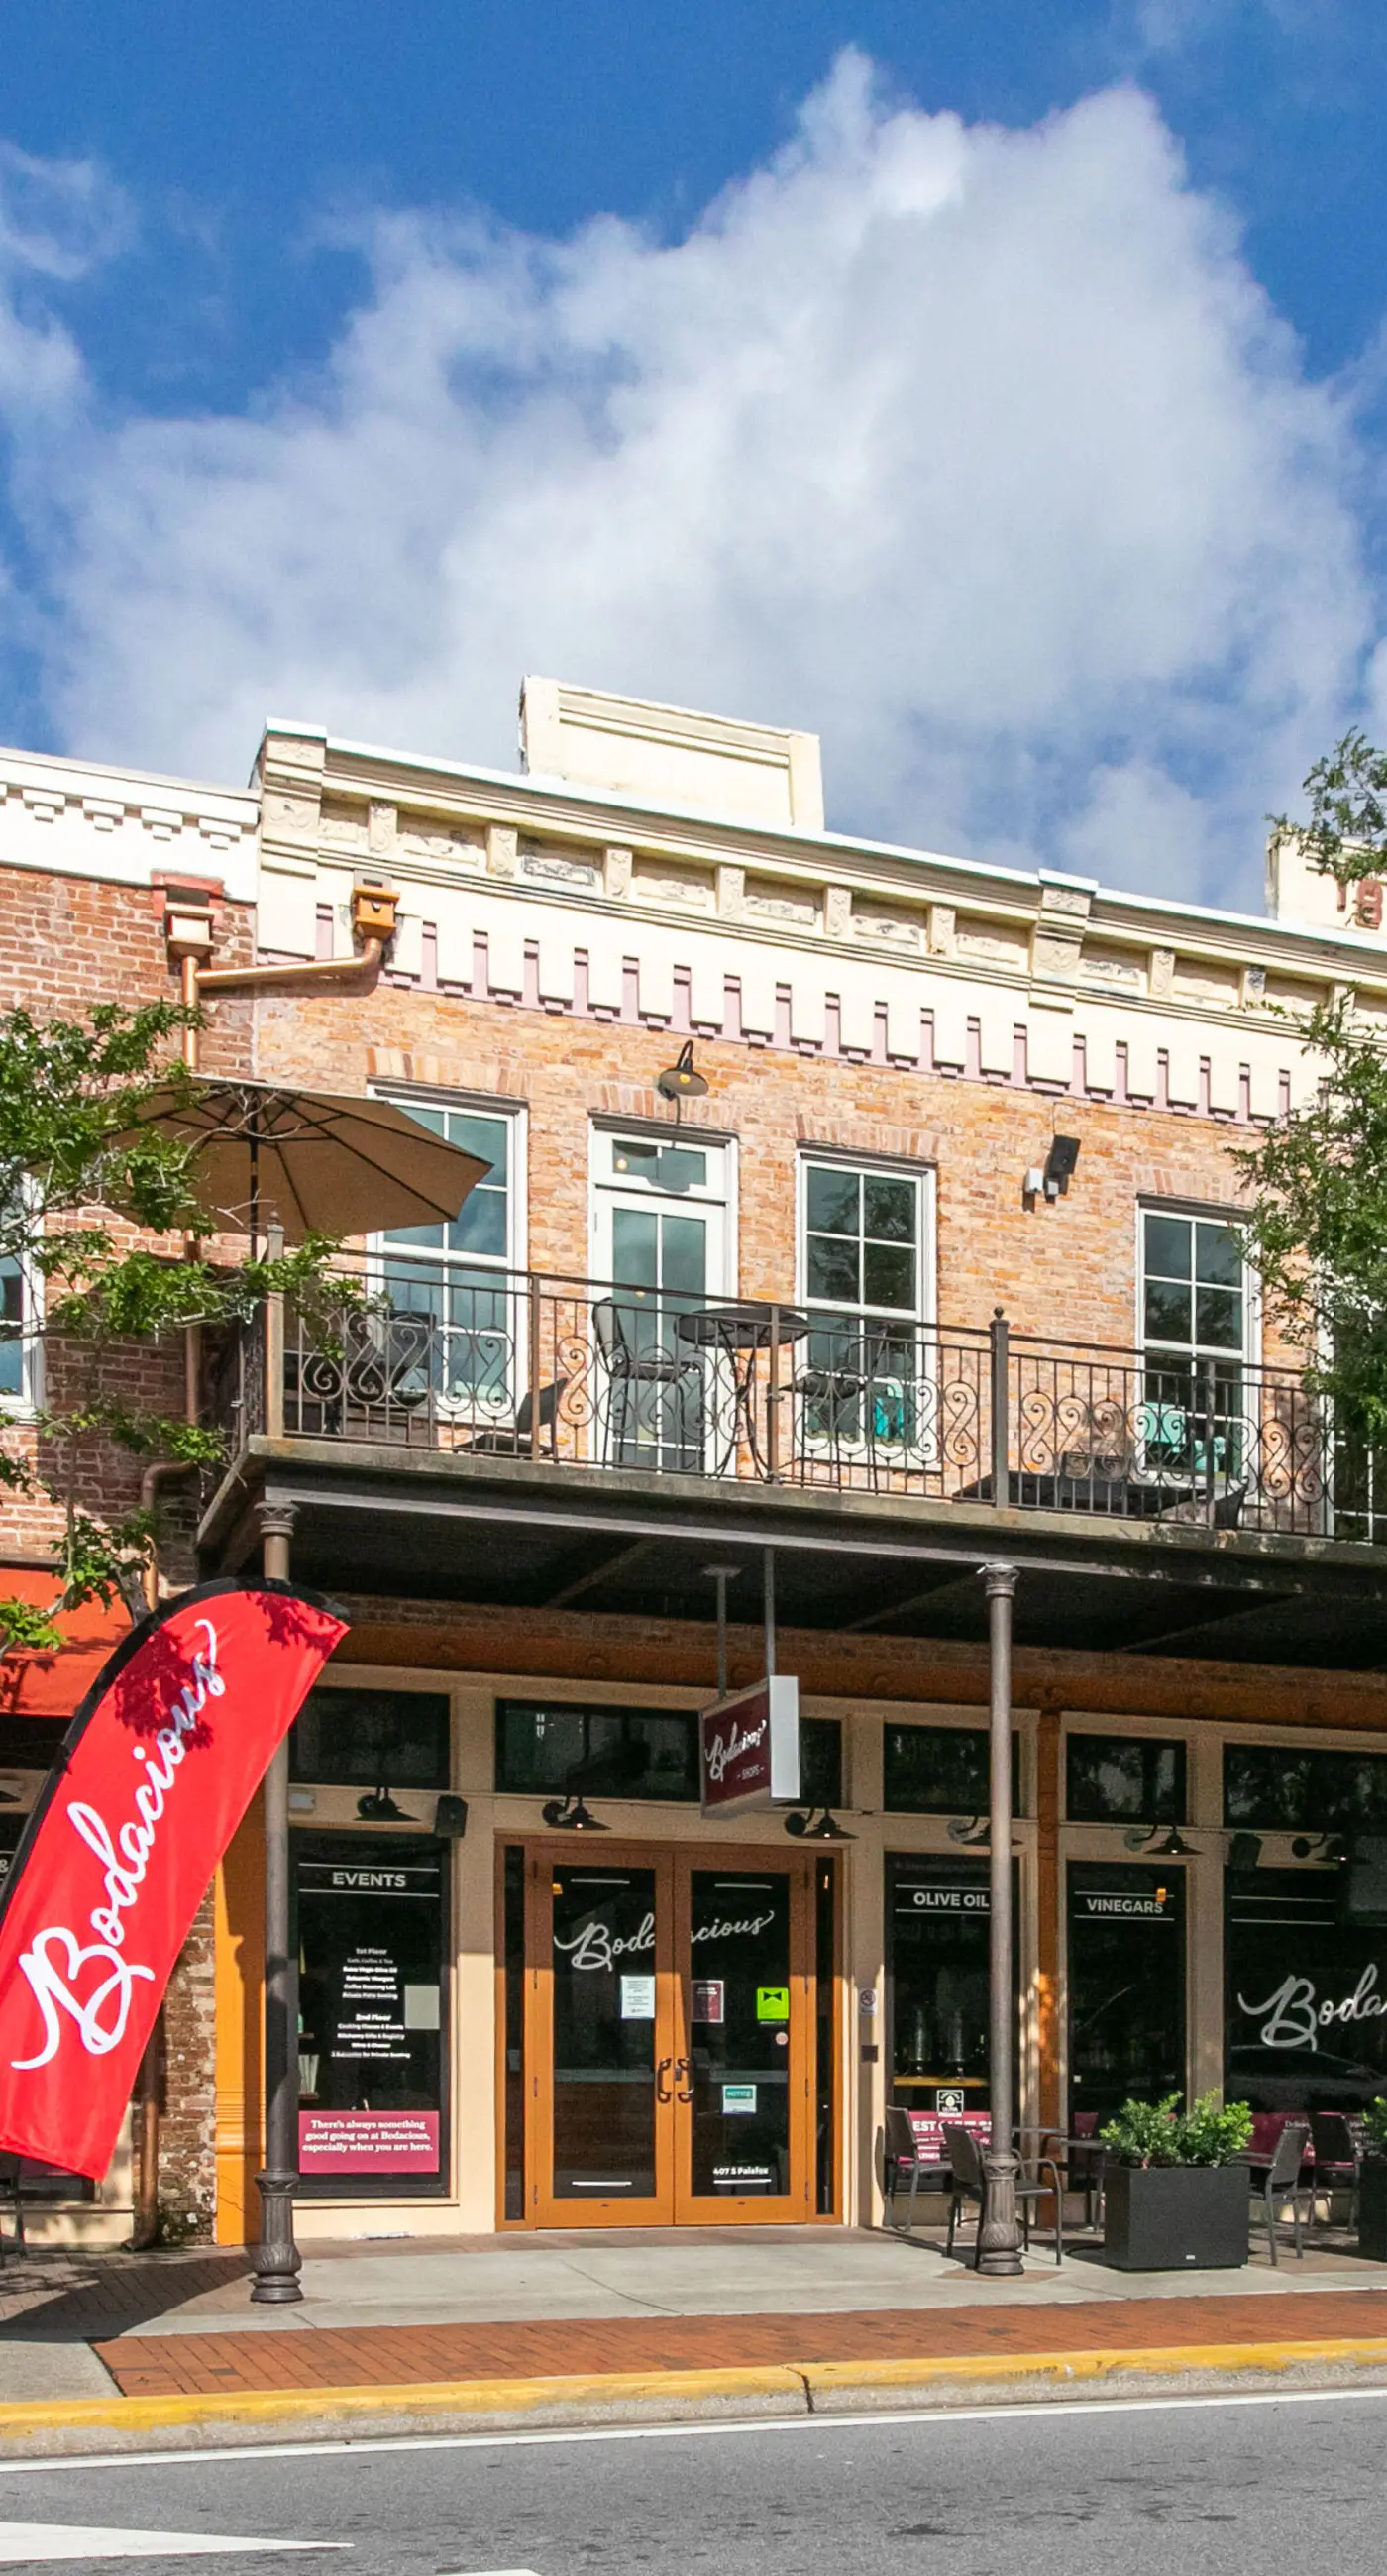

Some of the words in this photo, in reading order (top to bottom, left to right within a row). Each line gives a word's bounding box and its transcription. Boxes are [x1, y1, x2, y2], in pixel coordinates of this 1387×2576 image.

[11, 1619, 226, 2069] Bodacious
[332, 1872, 406, 1887] EVENTS
[913, 1891, 961, 1907] OLIVE
[963, 1893, 990, 1907] OIL
[1086, 1898, 1164, 1914] VINEGARS
[311, 2120, 344, 2129] There's
[346, 2120, 376, 2130] always
[377, 2120, 426, 2130] something
[912, 2120, 937, 2132] EST
[305, 2132, 328, 2142] good
[329, 2132, 356, 2142] going
[380, 2131, 430, 2141] Bodacious,
[302, 2143, 348, 2153] especially
[374, 2144, 392, 2153] you
[409, 2142, 433, 2151] here.
[738, 2166, 769, 2175] Palafox
